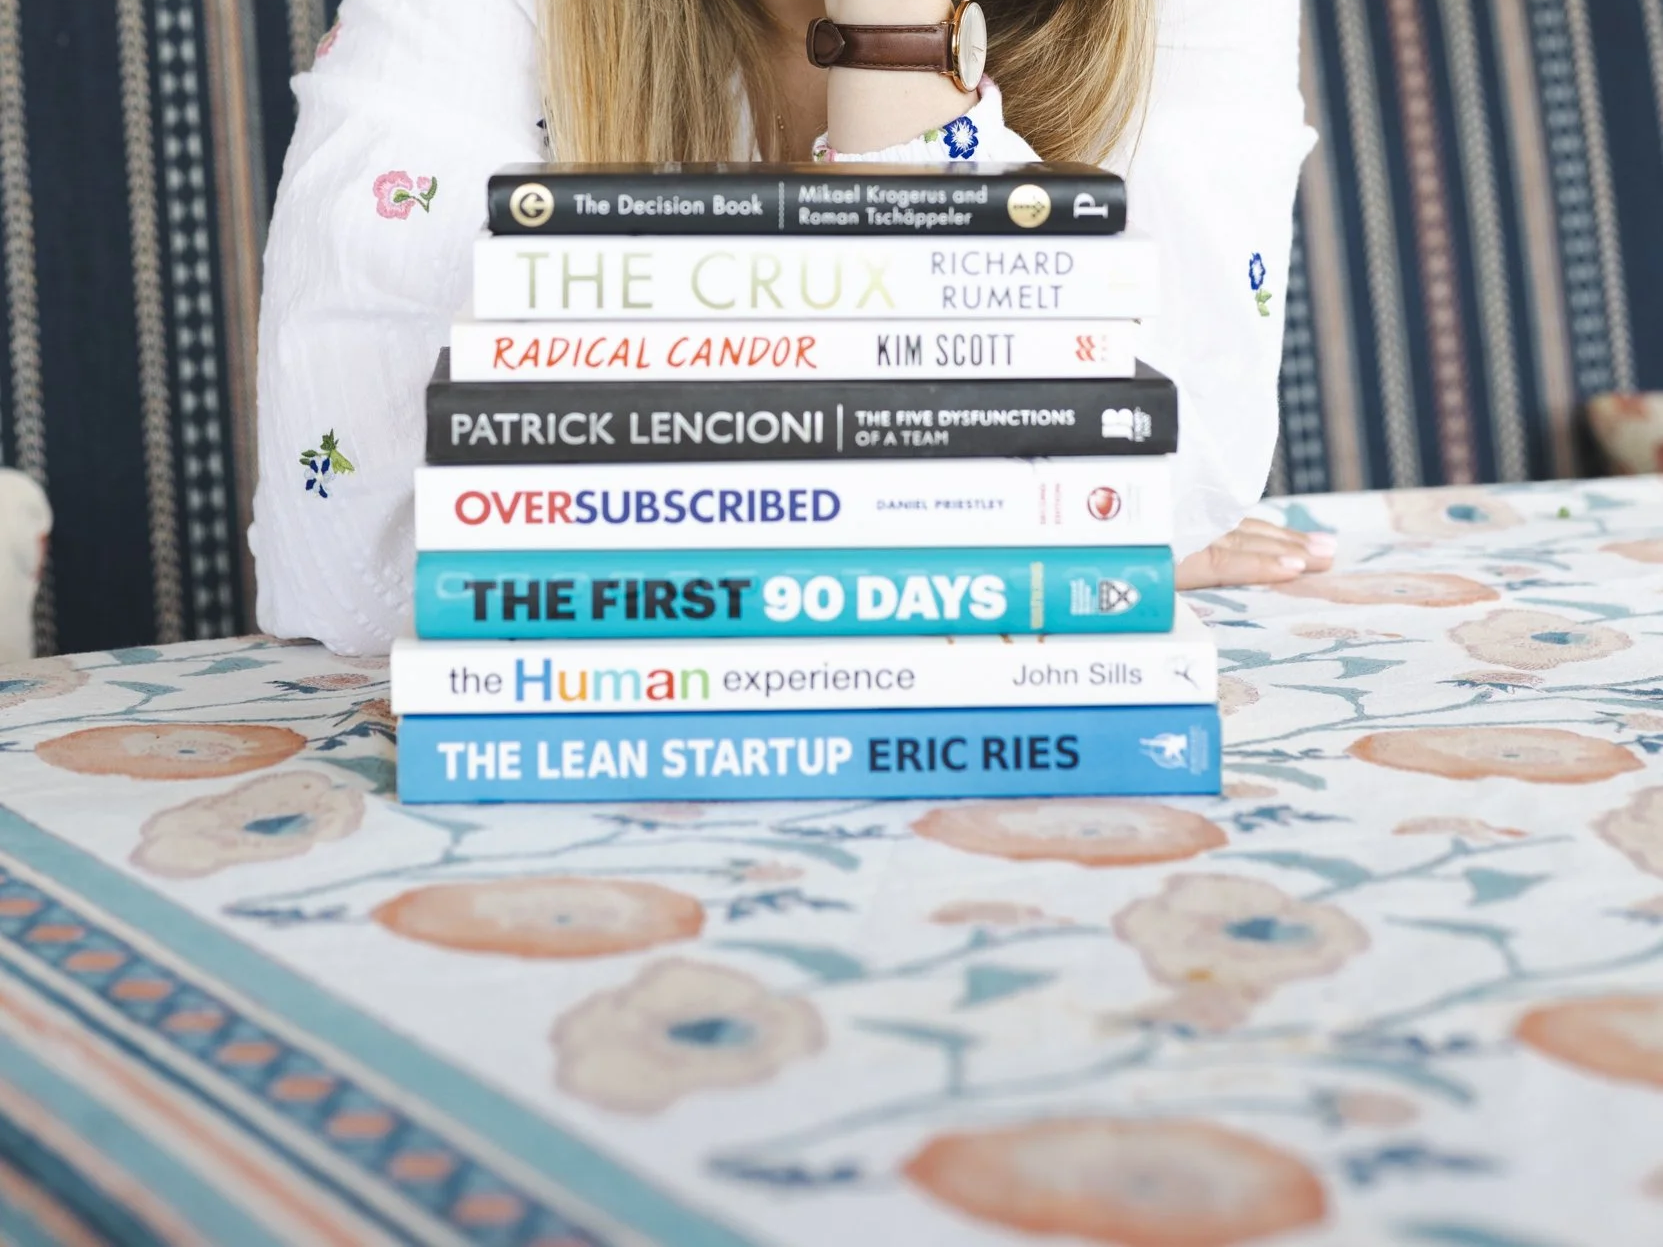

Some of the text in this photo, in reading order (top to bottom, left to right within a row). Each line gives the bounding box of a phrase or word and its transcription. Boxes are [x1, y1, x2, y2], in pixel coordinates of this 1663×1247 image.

[573, 193, 764, 216] The Decision Book
[798, 184, 989, 209] Mikael Krogerus and
[798, 206, 973, 230] Roman Tschäppeler
[931, 251, 1074, 276] RICHARD
[516, 250, 896, 311] THE CRUX
[942, 285, 1065, 310] RUMELT
[492, 335, 818, 370] RADICAL CANDOR
[877, 334, 1015, 367] KIM SCOTT
[450, 410, 824, 446] PATRICK LENCIONI
[854, 408, 1076, 428] THE FIVE DYSFUNCTIONS
[854, 429, 949, 447] OF A TEAM
[454, 489, 842, 526] OVERSUBSCRIBED
[876, 498, 1005, 511] DANIEL PRIESTLEY
[463, 579, 576, 622] THE
[591, 578, 752, 621] FIRST
[763, 575, 846, 622] 90
[856, 574, 1008, 621] DAYS
[449, 658, 916, 702] the Human experience
[1012, 662, 1143, 687] John Sills
[437, 734, 1081, 781] THE LEAN STARTUP ERIC RIES
